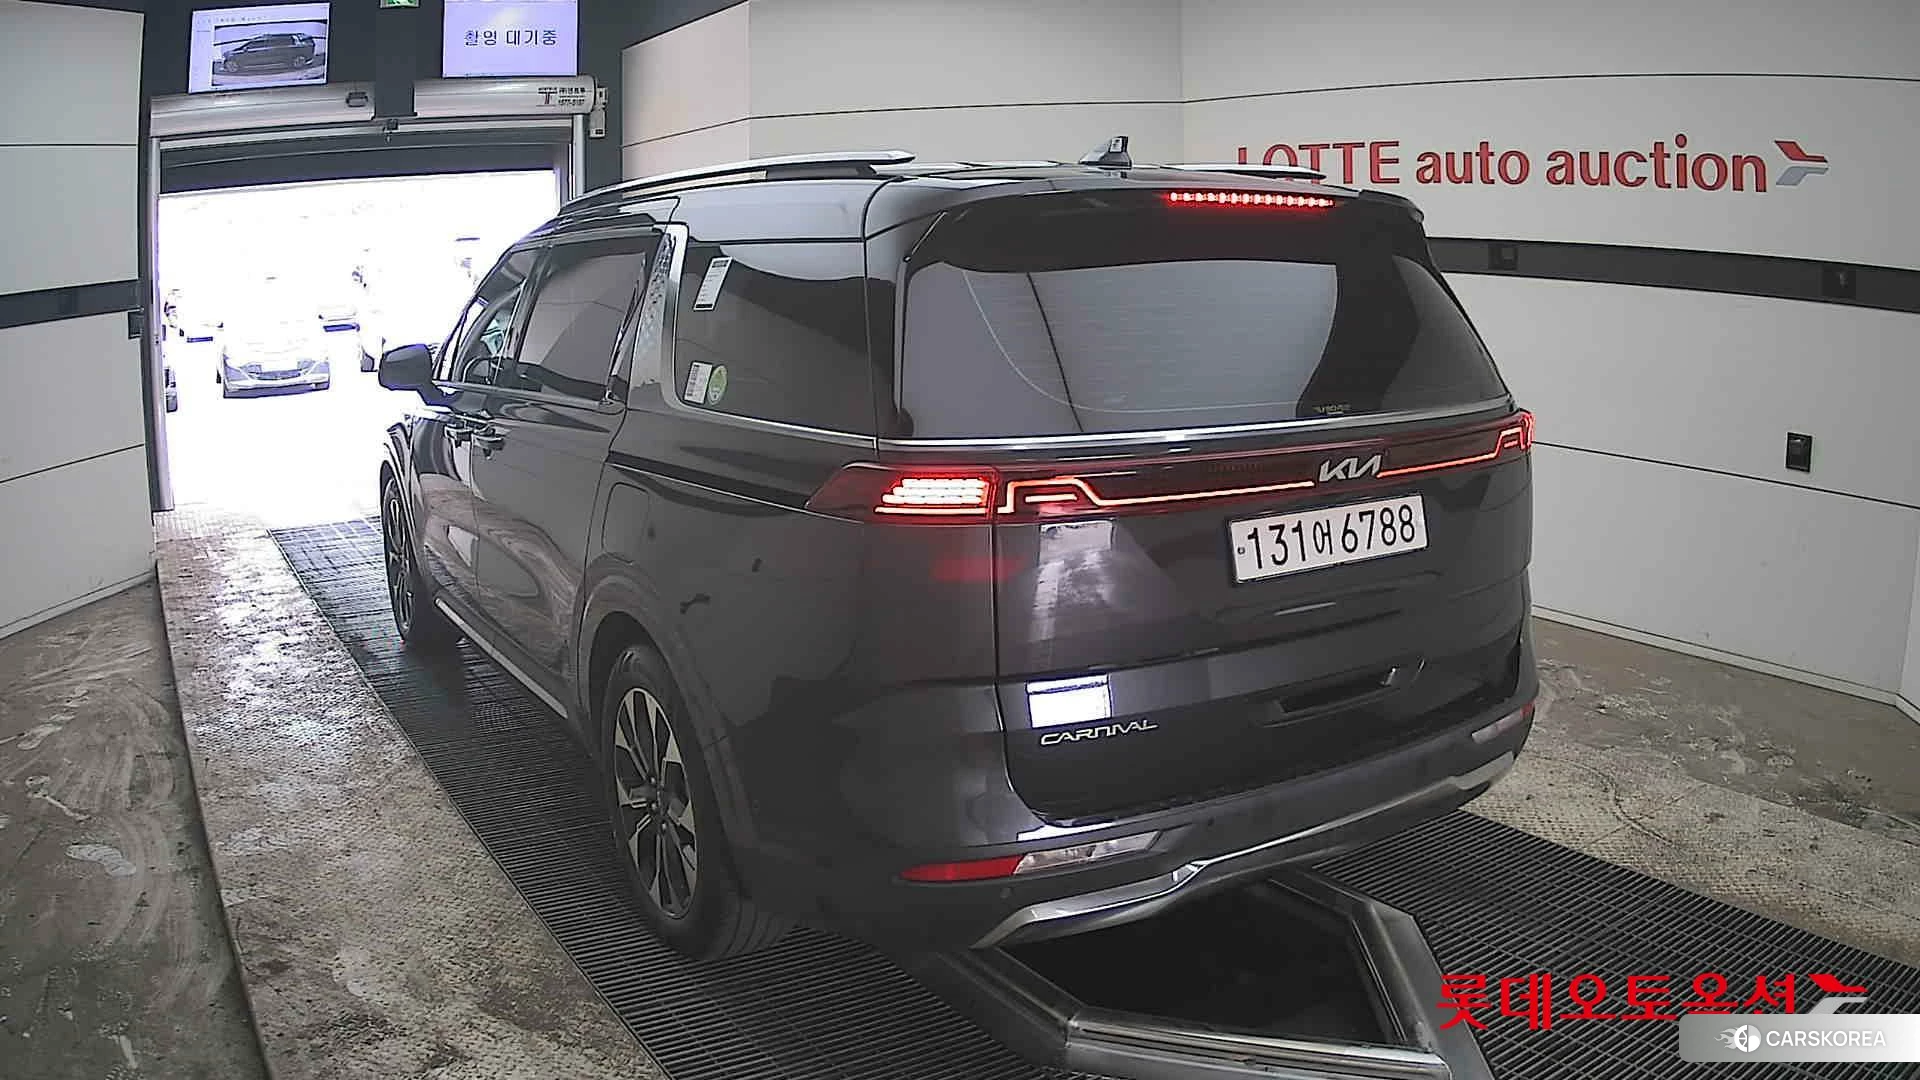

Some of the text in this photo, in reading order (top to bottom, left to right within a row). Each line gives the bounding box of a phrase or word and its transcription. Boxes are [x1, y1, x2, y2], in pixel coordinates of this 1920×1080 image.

[506, 29, 557, 46] 대기중
[1415, 141, 1530, 185] auto
[1546, 133, 1767, 193] auction
[1318, 454, 1383, 483] KIA
[1247, 504, 1416, 570] 131어6788
[1040, 719, 1159, 746] CARNIVAL
